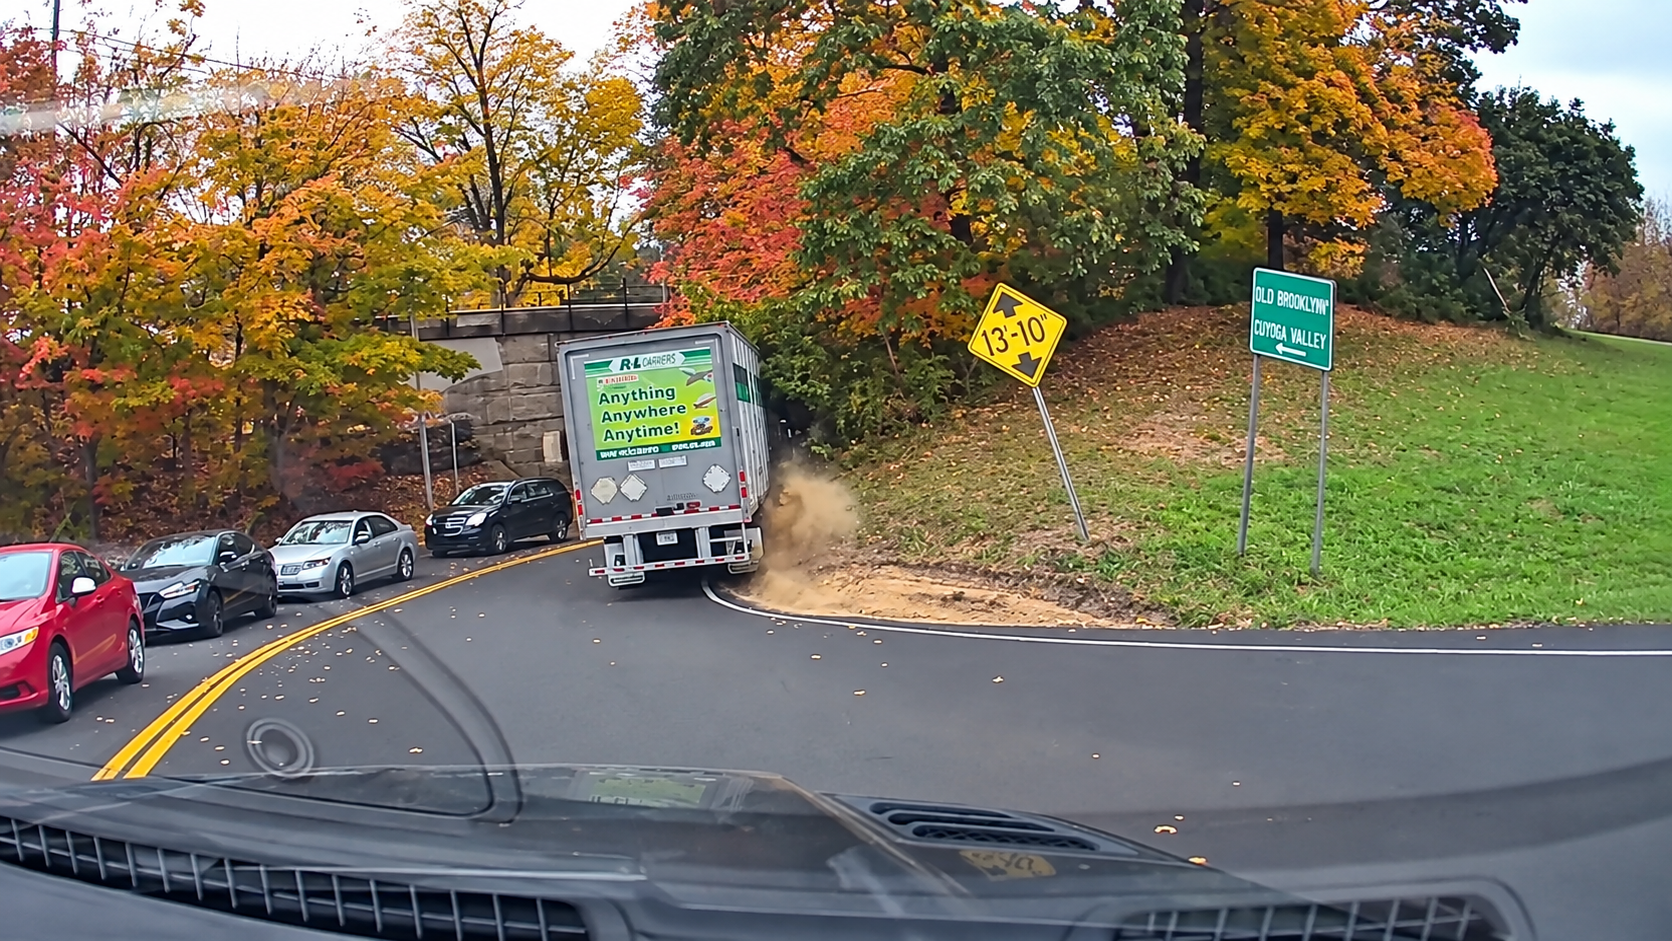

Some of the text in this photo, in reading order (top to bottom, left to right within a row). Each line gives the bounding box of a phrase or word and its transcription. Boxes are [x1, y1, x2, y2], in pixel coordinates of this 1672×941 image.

[1255, 286, 1274, 304] OLD
[1290, 327, 1326, 349] VALLEY
[598, 386, 676, 406] Anything
[601, 404, 686, 423] Anywhere
[603, 422, 679, 443] Anytime!
